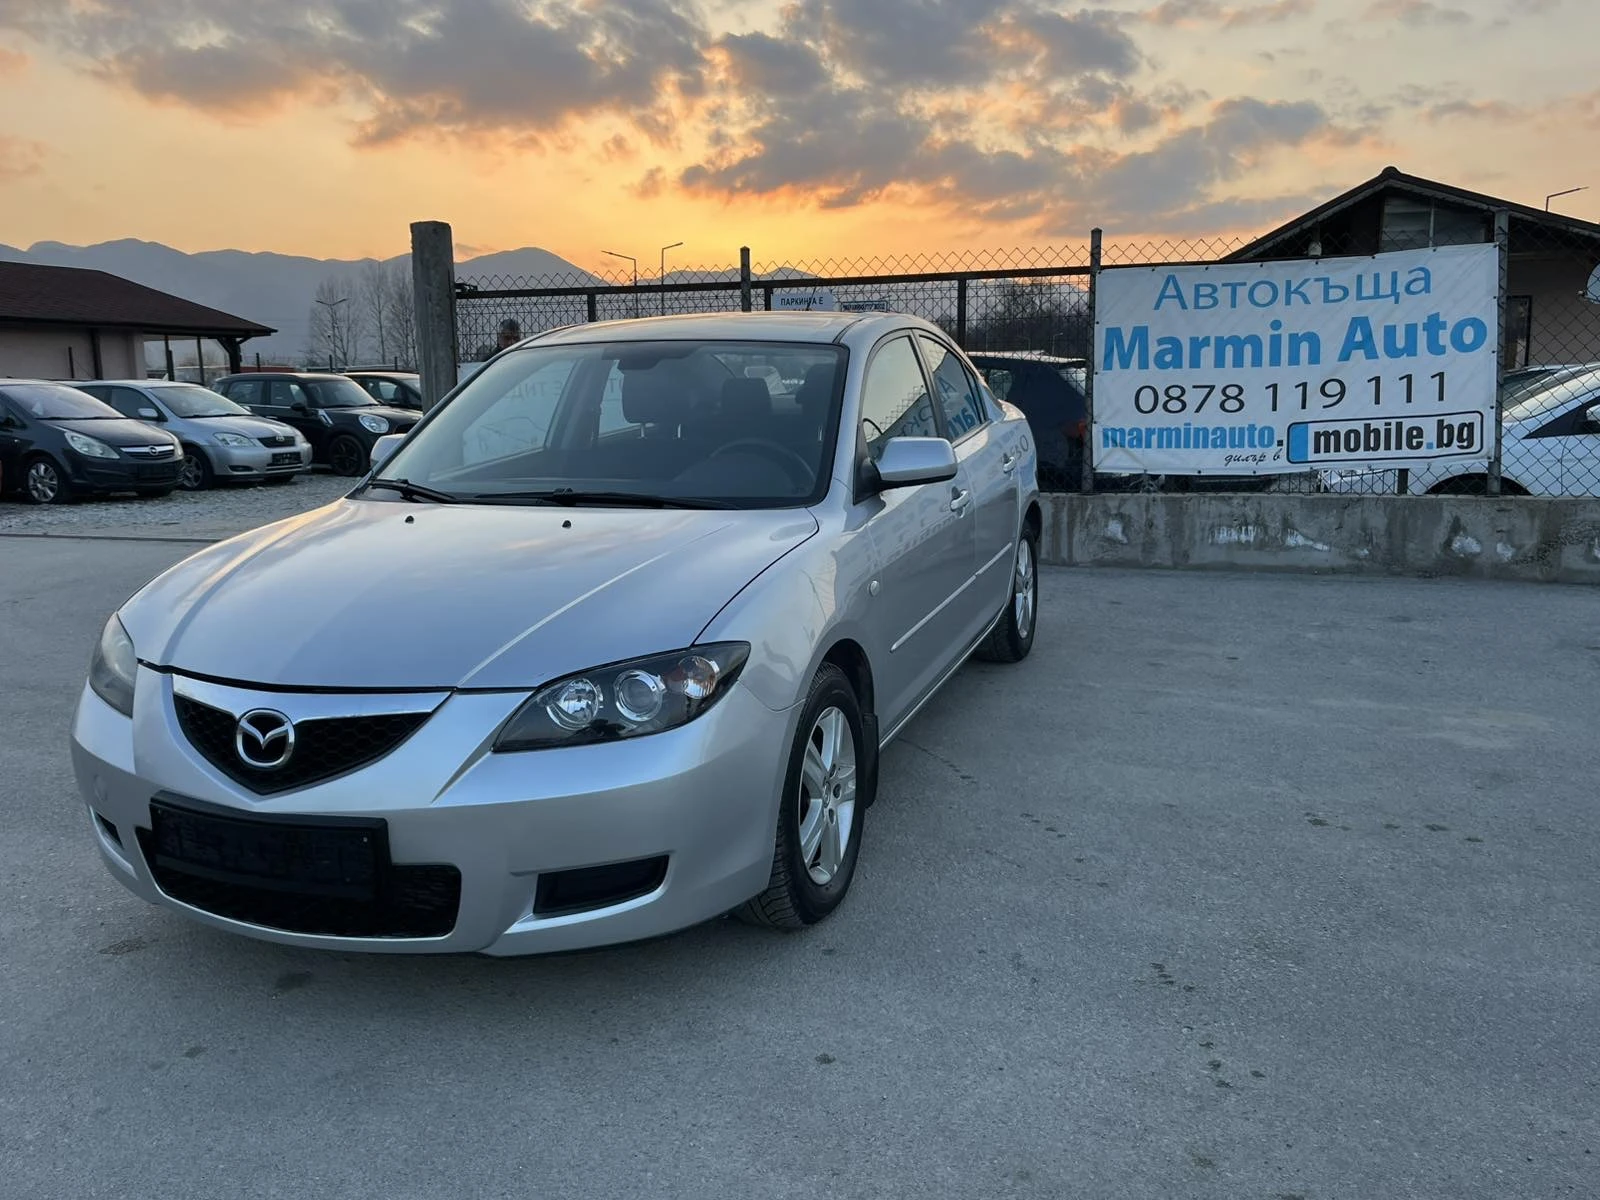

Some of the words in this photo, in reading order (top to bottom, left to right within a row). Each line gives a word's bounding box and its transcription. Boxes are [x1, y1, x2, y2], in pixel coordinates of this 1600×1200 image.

[1153, 266, 1432, 311] Автокъща
[1102, 319, 1321, 371] Marmin
[1337, 311, 1488, 363] Auto
[1133, 383, 1245, 414] 0878
[1264, 378, 1347, 411] 119
[1367, 371, 1447, 406] 111
[1313, 418, 1476, 454] mobile.bg
